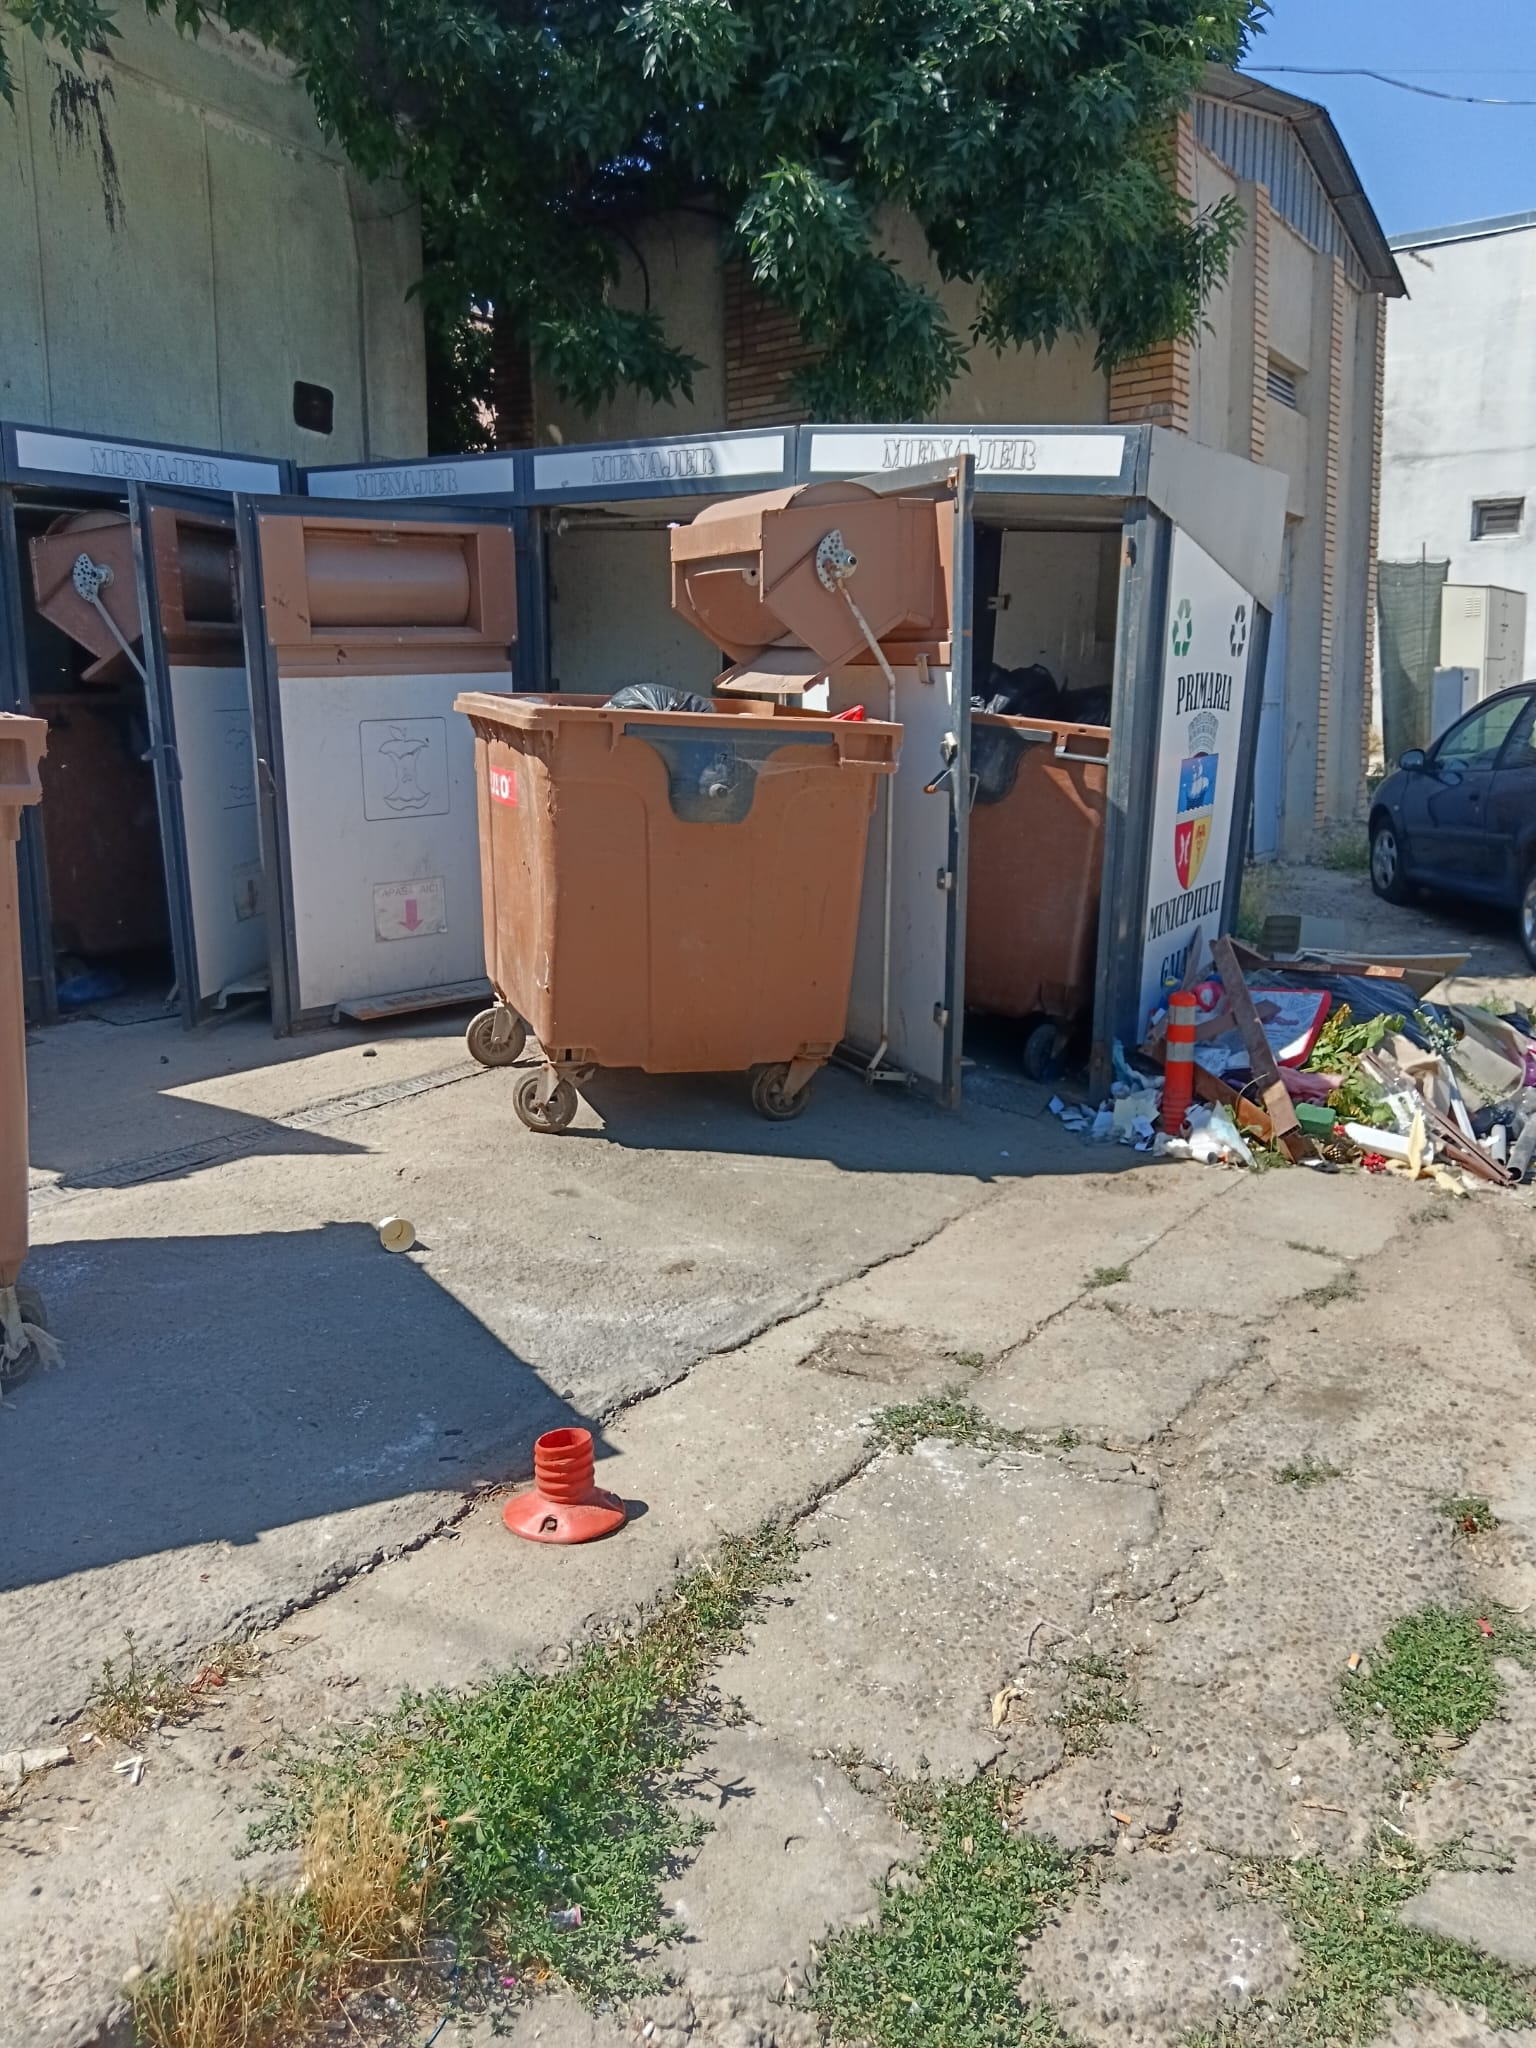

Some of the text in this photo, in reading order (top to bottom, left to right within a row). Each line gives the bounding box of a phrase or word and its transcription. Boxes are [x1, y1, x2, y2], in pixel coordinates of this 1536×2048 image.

[90, 446, 222, 488] MENAJER
[354, 467, 458, 498] MENAJER
[591, 447, 716, 483] MENAJER
[1176, 671, 1232, 716] PRIMARIA
[1147, 880, 1221, 943] MUNICIPIULUI
